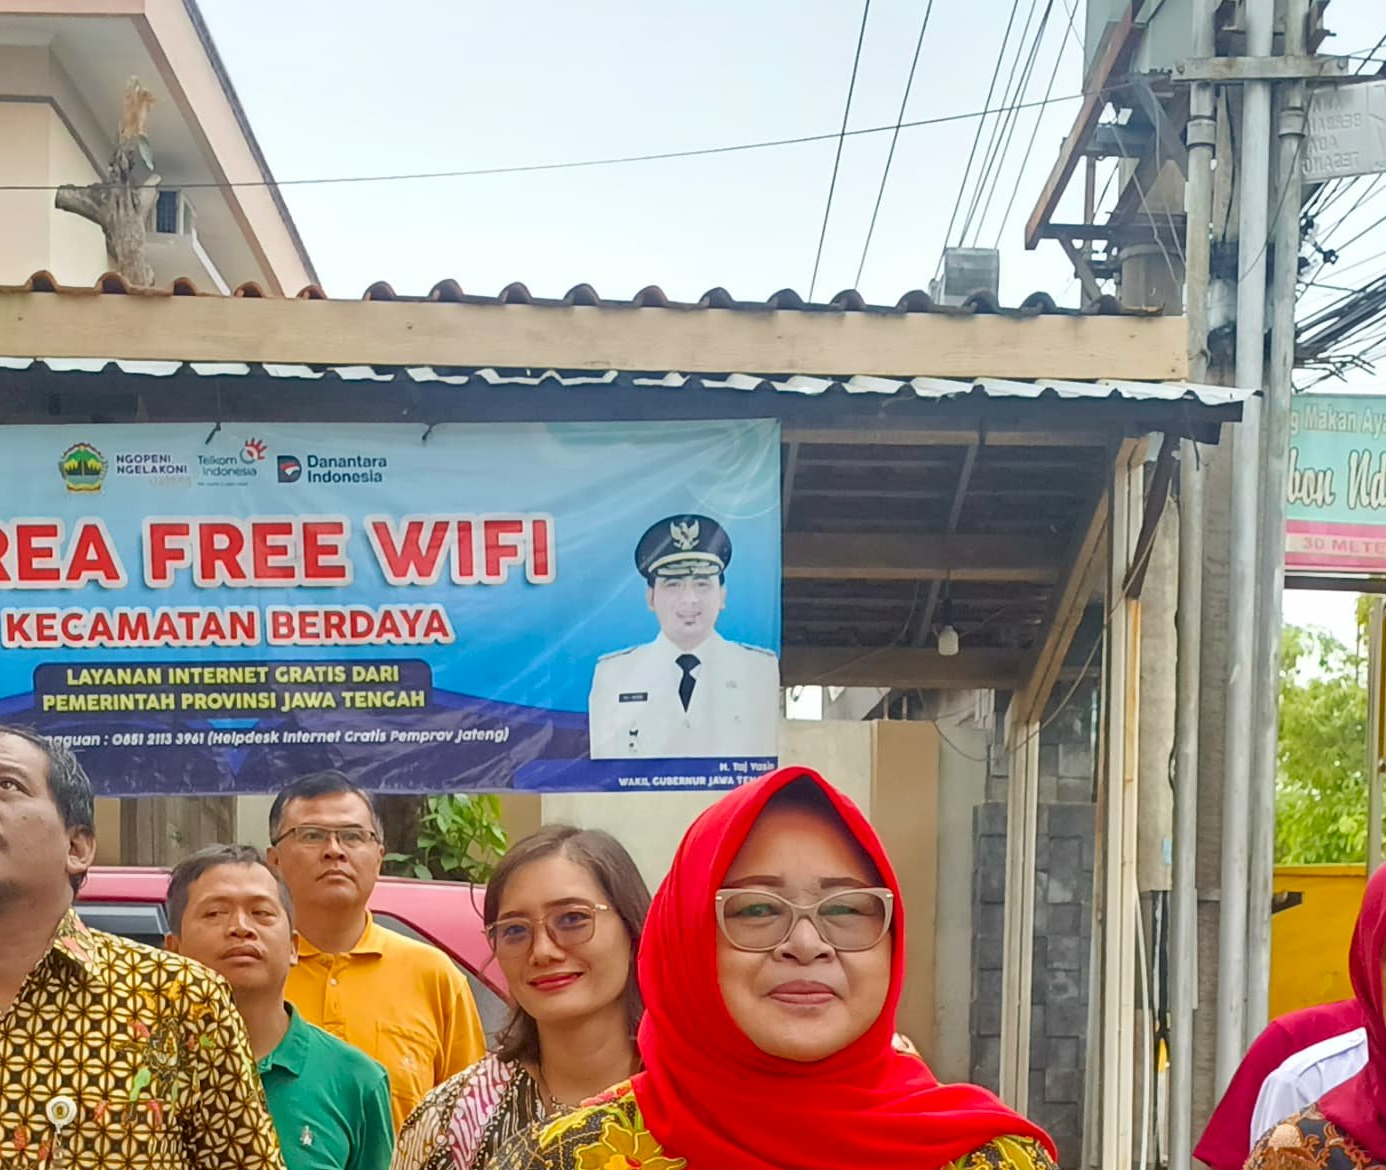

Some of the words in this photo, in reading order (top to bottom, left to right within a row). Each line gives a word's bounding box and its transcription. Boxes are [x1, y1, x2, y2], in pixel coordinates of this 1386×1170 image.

[1305, 405, 1357, 432] Makan
[116, 453, 171, 464] NGOPENI
[197, 454, 238, 466] Telkom
[307, 454, 388, 468] Danantara
[116, 464, 188, 475] NGELAKONI
[202, 466, 258, 478] Indonesia
[307, 470, 383, 484] Indonesia
[147, 518, 348, 583] FREE
[368, 516, 551, 582] WIFI
[5, 609, 258, 645] KECAMATAN
[271, 607, 451, 641] BERDAYA
[66, 668, 162, 686] LAYANAN
[168, 667, 269, 685] INTERNET
[275, 666, 347, 683] GRATIS
[352, 665, 400, 682] DARI
[42, 694, 175, 712] PEMERINTAH
[181, 692, 276, 710] PROVINSI
[281, 691, 337, 712] JAWA
[342, 691, 425, 708] TENGAH
[112, 733, 144, 746] 0851
[147, 733, 173, 746] 2113
[176, 732, 205, 746] 3961
[207, 731, 279, 748] (Helpdesk
[283, 730, 341, 744] Internet
[344, 729, 387, 743] Gratis
[390, 729, 453, 745] Pemprov
[454, 727, 510, 744] Jateng)
[618, 777, 650, 787] WAKIL
[652, 776, 706, 786] GUBERNUR
[708, 776, 734, 787] JAWA
